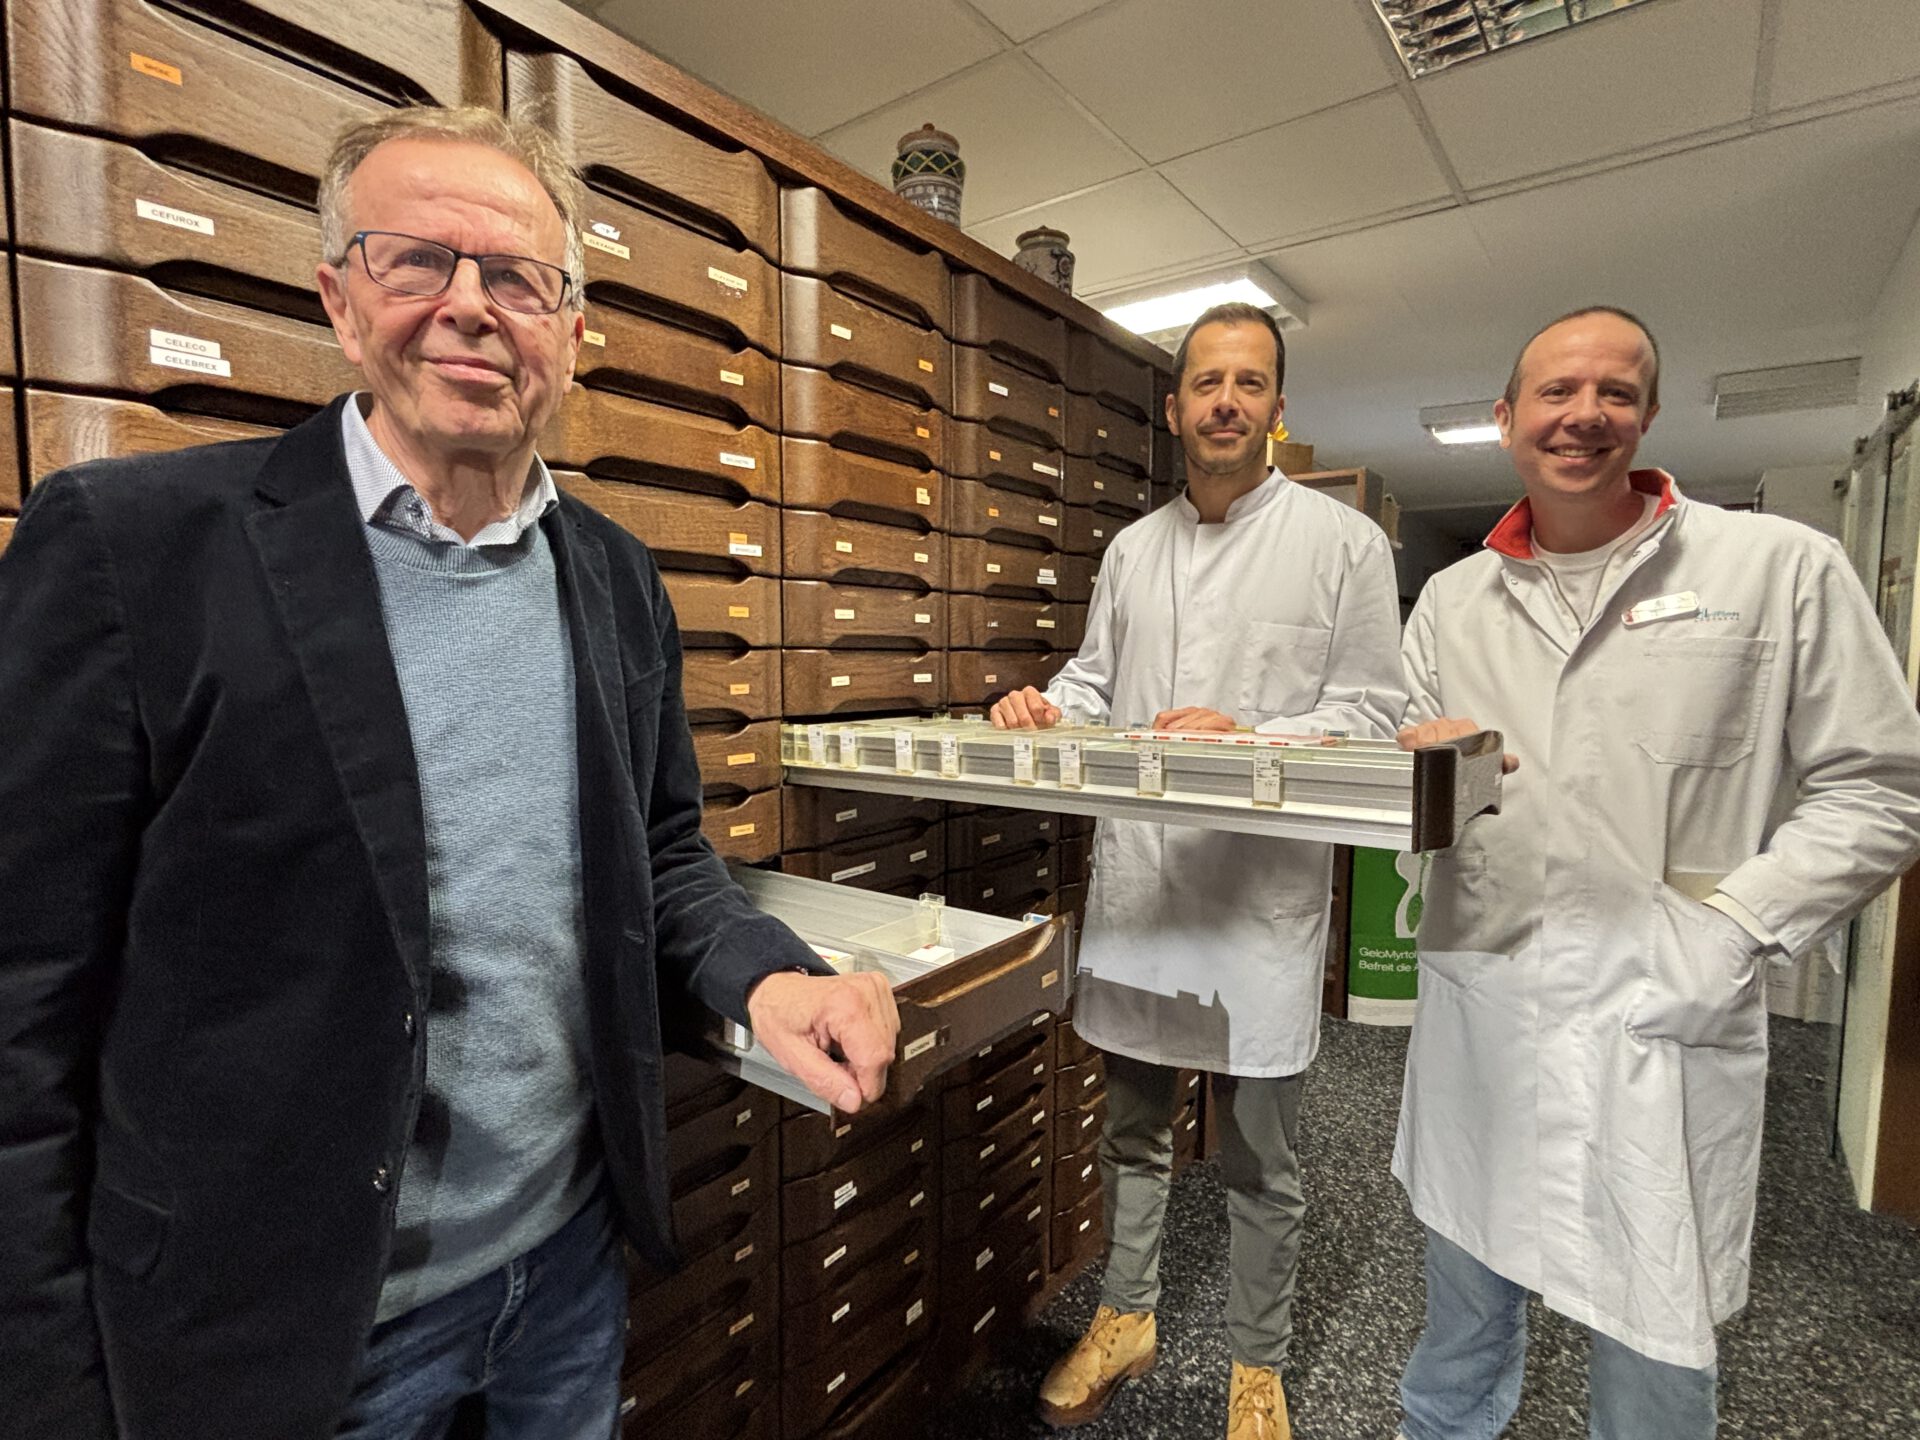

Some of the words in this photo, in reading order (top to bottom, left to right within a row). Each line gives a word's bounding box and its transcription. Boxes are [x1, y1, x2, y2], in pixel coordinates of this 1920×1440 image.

[151, 208, 200, 228] CEFUROX
[165, 337, 207, 353] CELECO
[165, 355, 217, 372] CELEBREX
[1359, 960, 1393, 971] Befreit
[1396, 963, 1411, 971] die
